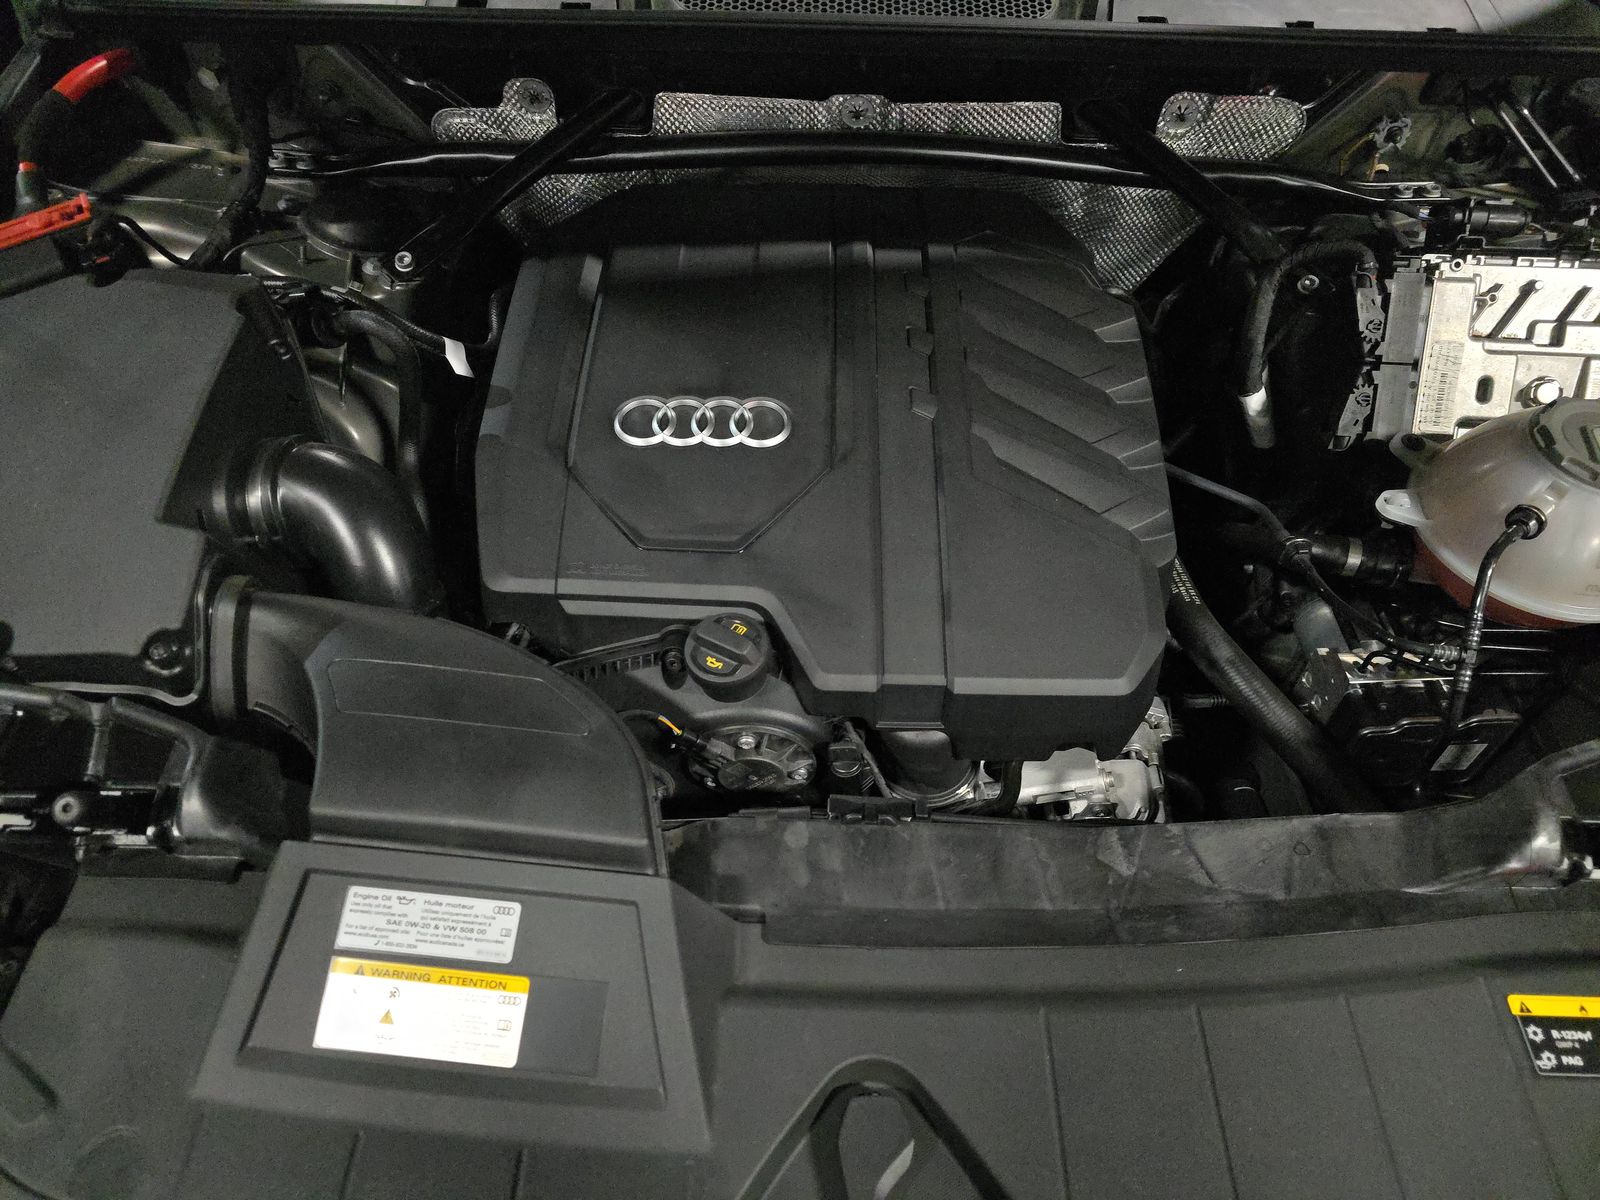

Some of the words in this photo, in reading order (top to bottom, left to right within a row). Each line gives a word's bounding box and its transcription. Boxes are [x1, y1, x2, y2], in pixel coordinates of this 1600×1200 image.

[353, 892, 379, 900] Engine
[424, 899, 443, 907] Huile
[445, 902, 474, 910] moteur
[385, 919, 404, 927] SAE
[404, 920, 431, 929] 0W-20
[442, 925, 458, 933] VW
[370, 967, 431, 983] WARNING
[438, 975, 508, 991] ATTENTION
